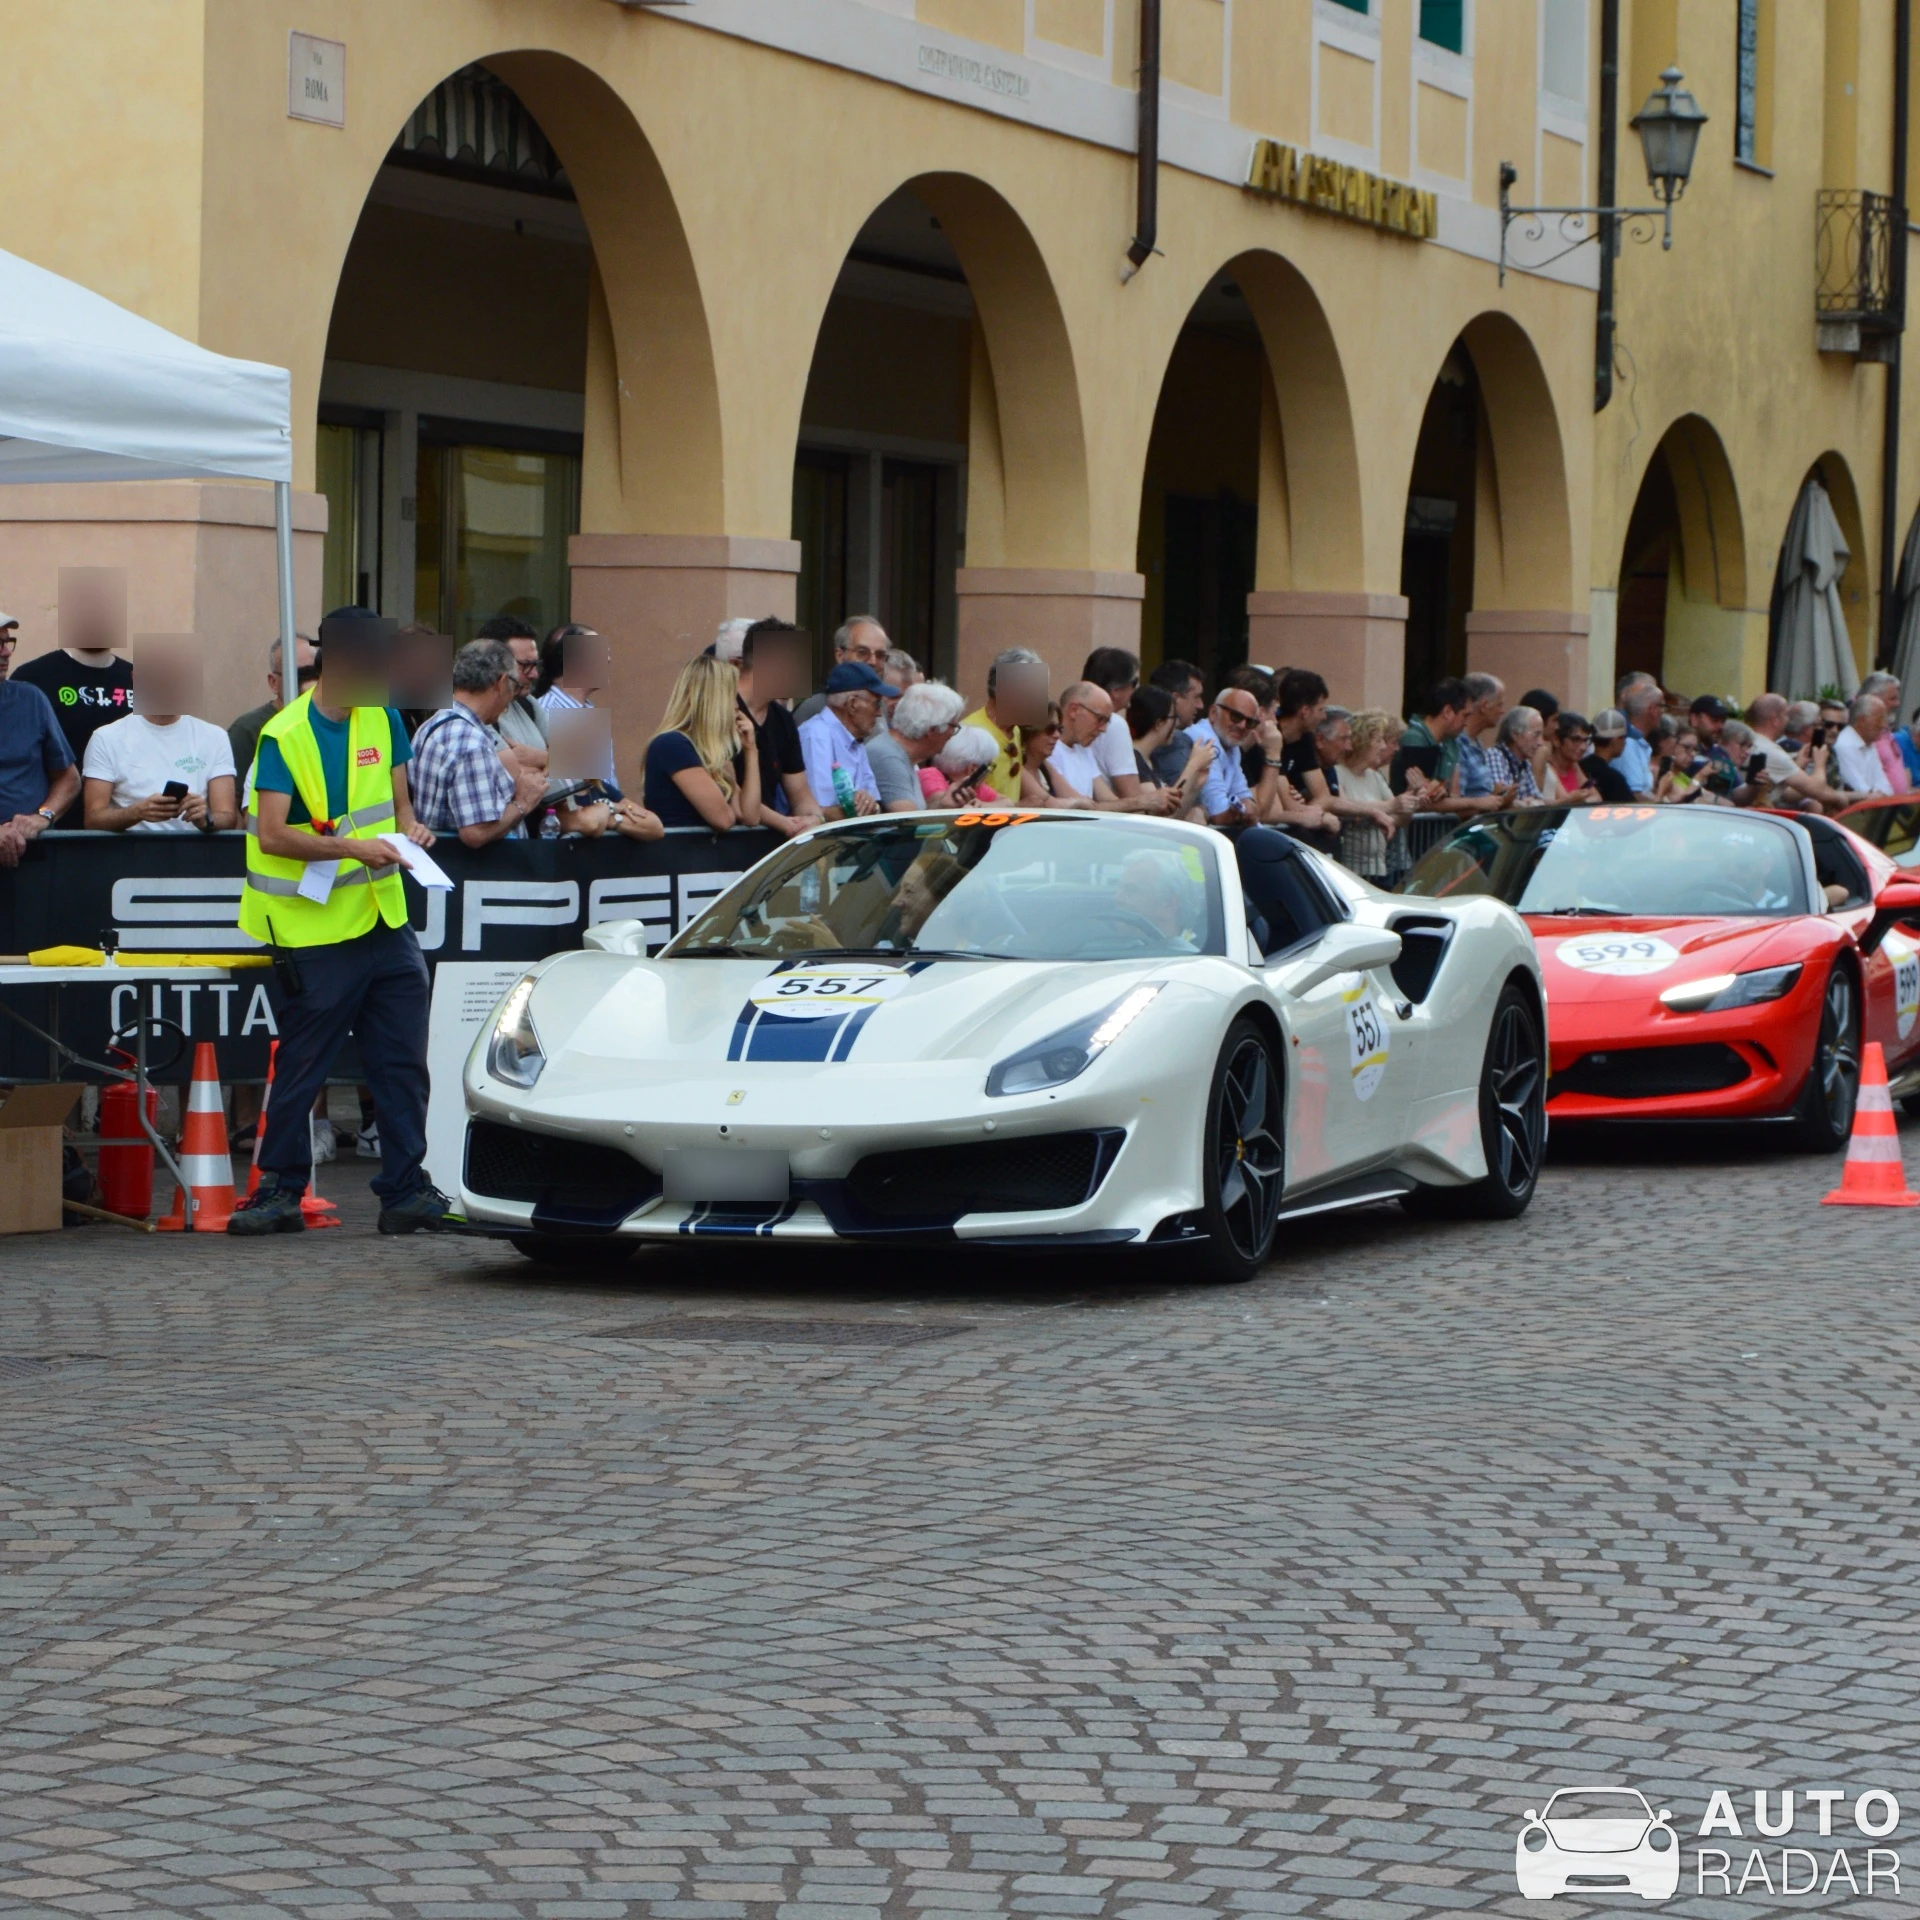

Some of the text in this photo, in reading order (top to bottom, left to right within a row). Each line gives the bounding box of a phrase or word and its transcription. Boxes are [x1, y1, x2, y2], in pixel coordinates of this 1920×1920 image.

[305, 77, 328, 101] ROMA
[954, 812, 1041, 827] 557
[1588, 806, 1657, 821] 599
[1576, 942, 1656, 962] 599
[776, 978, 887, 995] 557
[1900, 963, 1917, 1004] 599
[1351, 1001, 1381, 1057] 557
